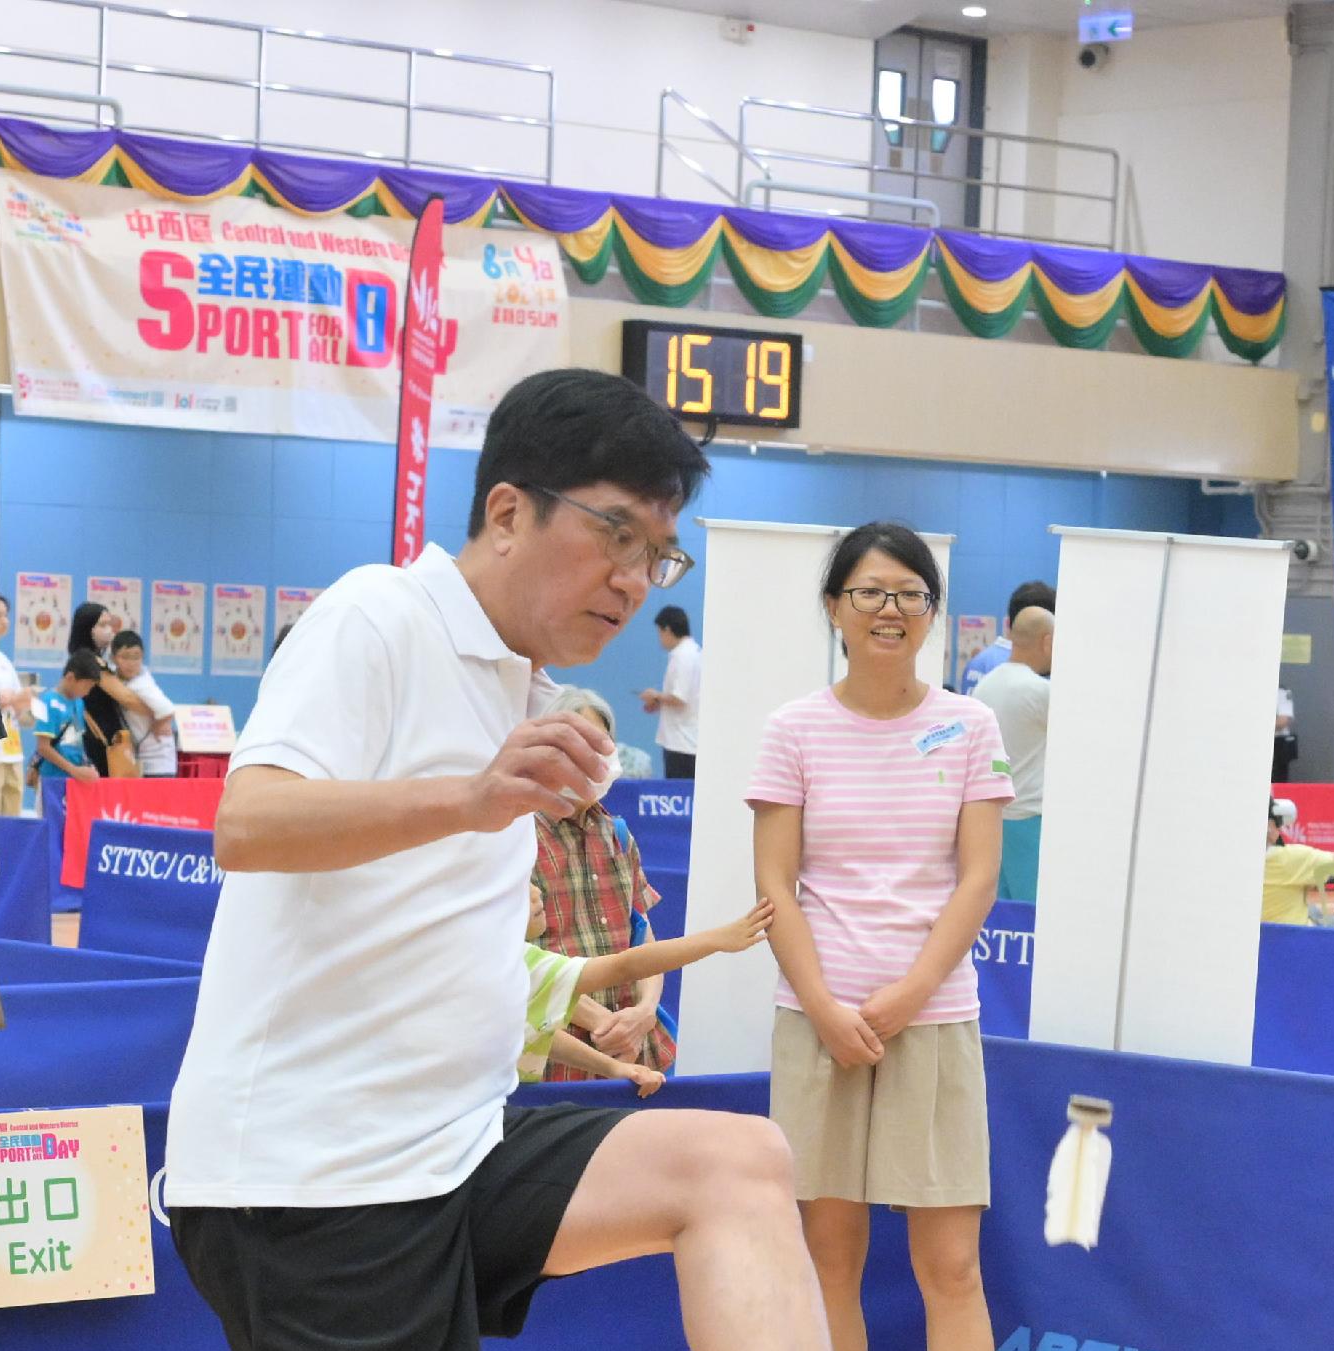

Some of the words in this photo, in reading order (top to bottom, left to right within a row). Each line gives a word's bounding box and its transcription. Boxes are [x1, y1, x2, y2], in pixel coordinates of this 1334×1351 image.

[125, 208, 213, 243] 中西區
[222, 220, 285, 245] Central
[285, 230, 317, 250] and
[318, 231, 389, 258] Western
[137, 249, 303, 360] SPORT
[197, 253, 343, 307] 全民運動
[667, 334, 713, 413] 15
[745, 341, 792, 420] 19
[9, 1238, 73, 1275] Exit
